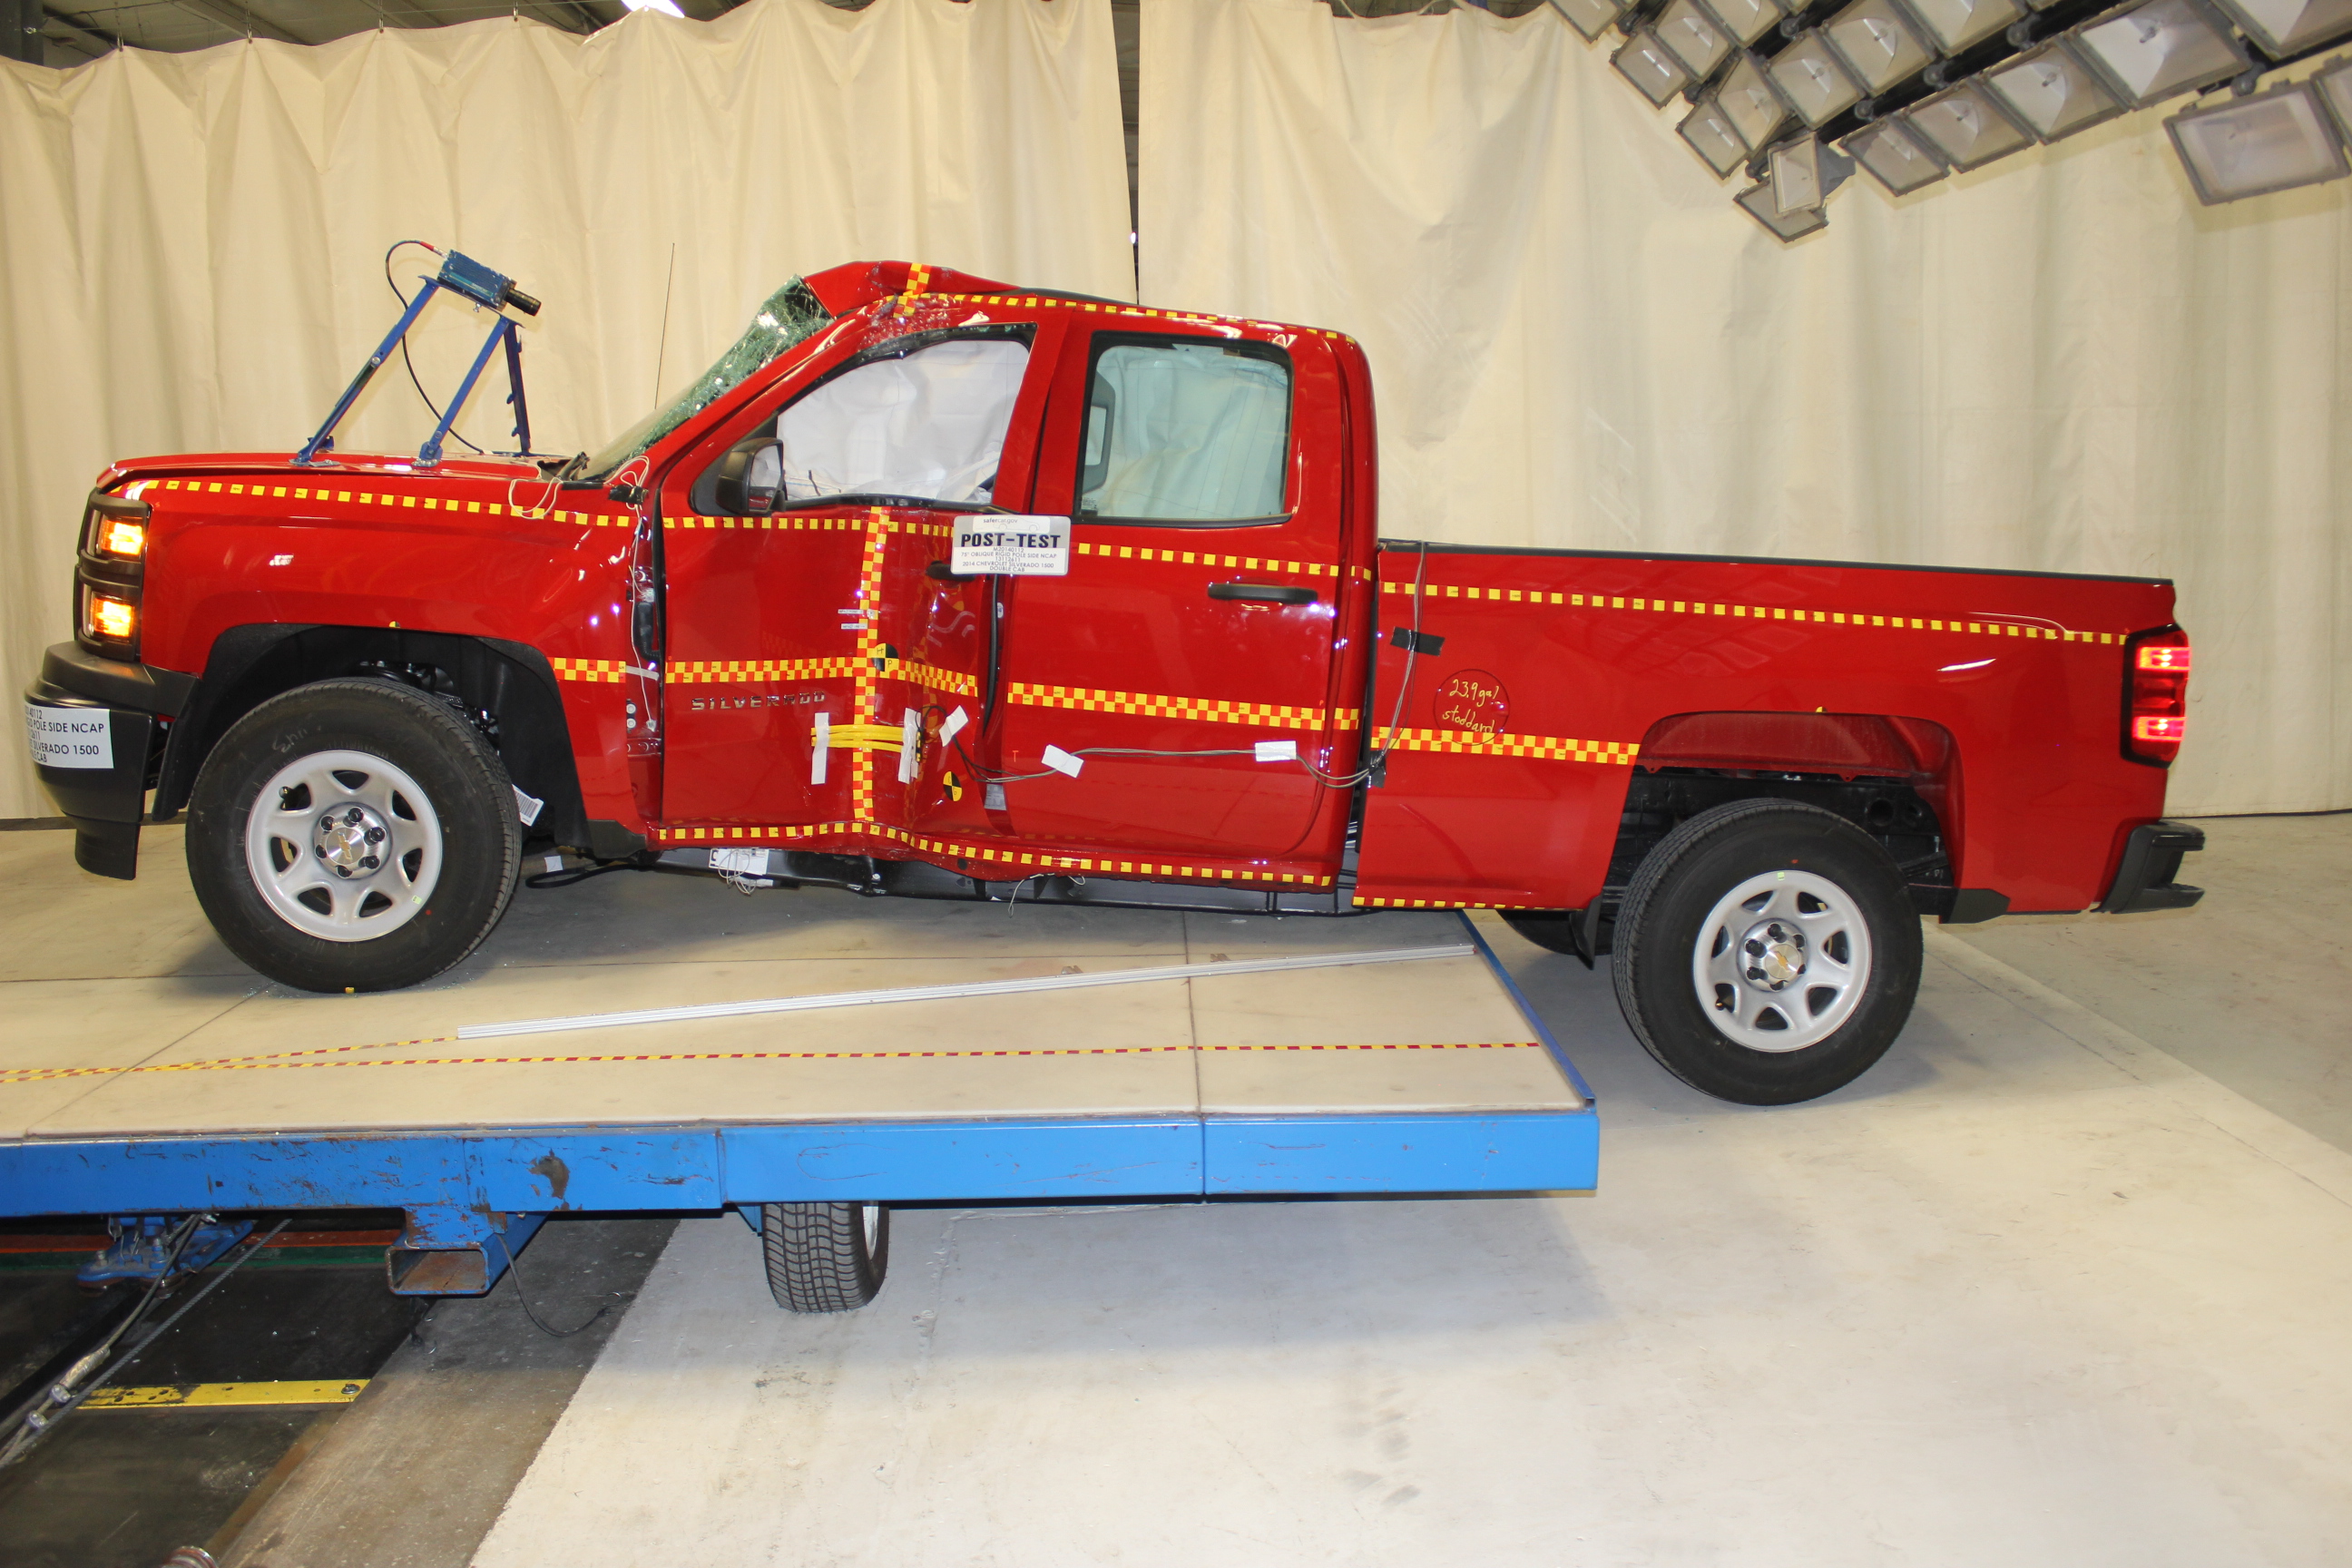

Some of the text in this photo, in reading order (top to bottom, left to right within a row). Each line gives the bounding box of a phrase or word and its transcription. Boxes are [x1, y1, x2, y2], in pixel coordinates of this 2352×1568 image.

[983, 516, 1018, 524] safercar.gov
[960, 532, 1062, 548] POST-TEST
[691, 691, 826, 710] SILVERADO
[34, 719, 47, 731] POLE
[48, 721, 68, 732] SIDE
[71, 722, 104, 733] NCAP
[34, 740, 70, 754] SILVERADO
[73, 744, 99, 755] 1500
[37, 752, 47, 762] CAB
